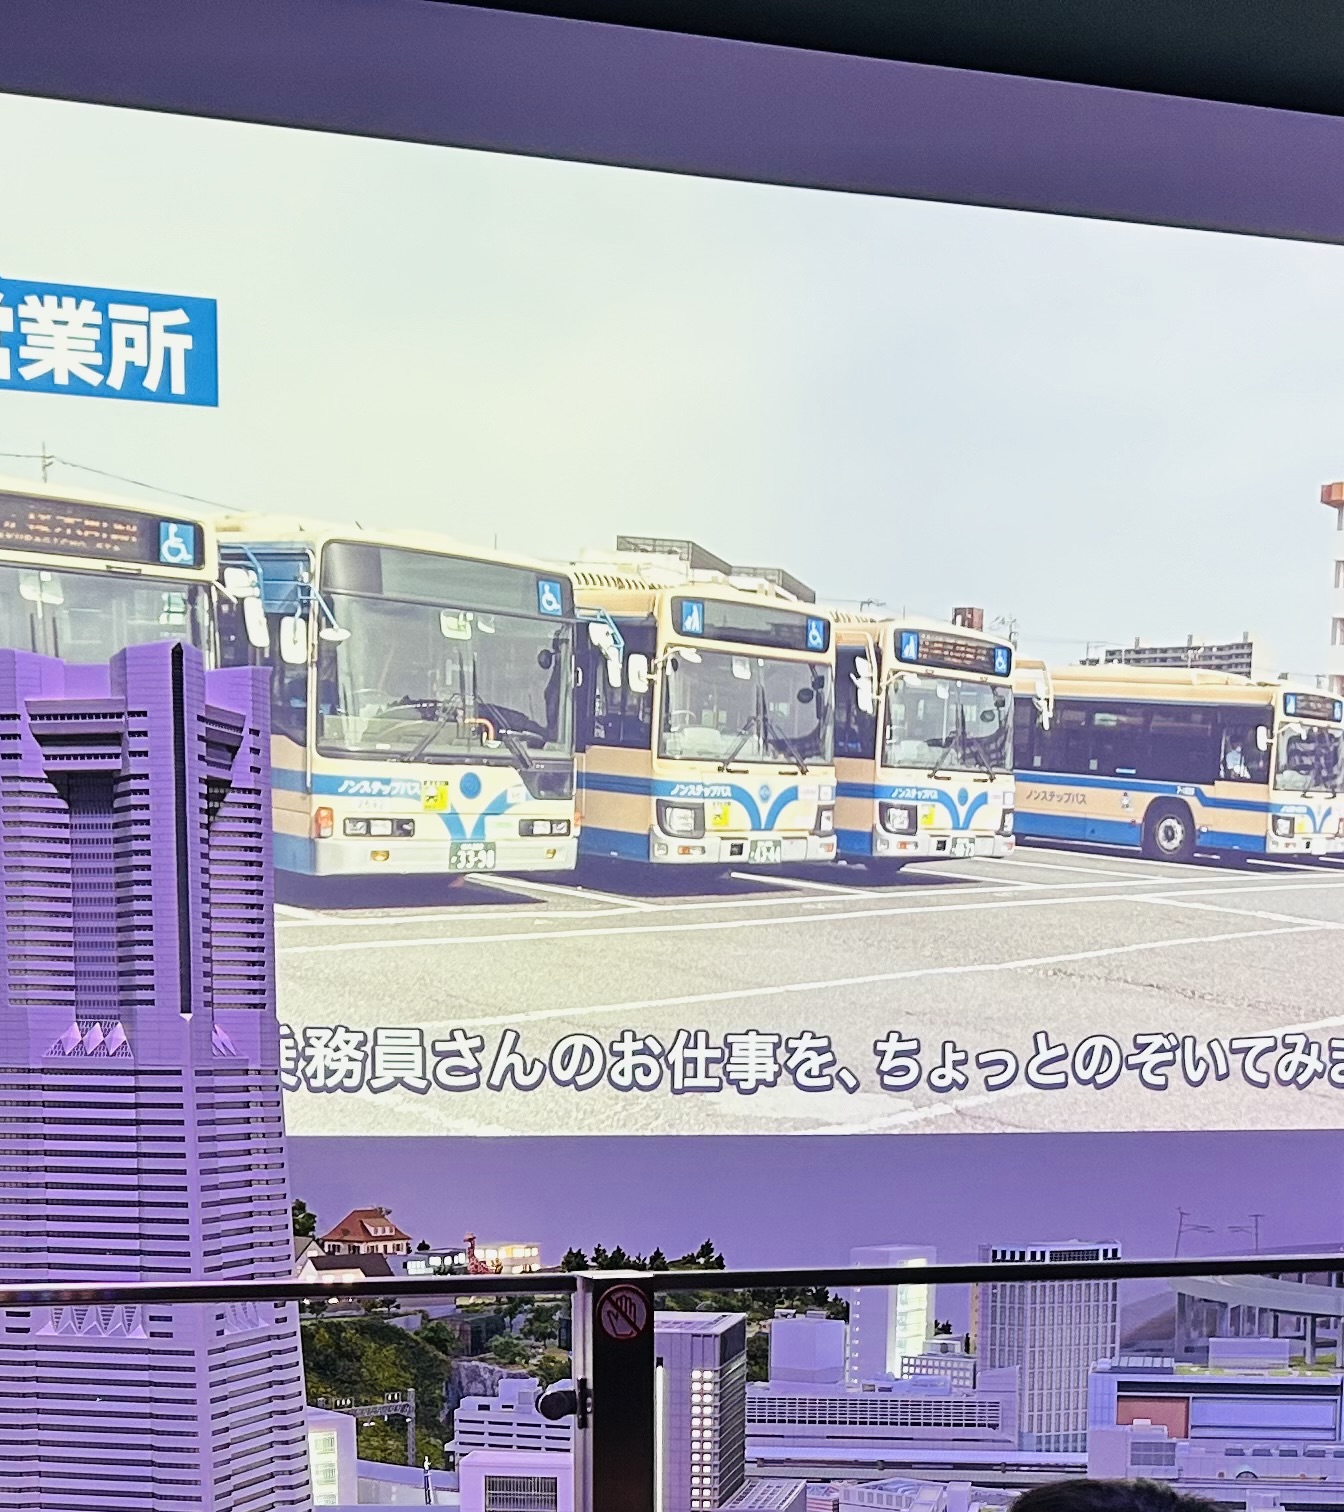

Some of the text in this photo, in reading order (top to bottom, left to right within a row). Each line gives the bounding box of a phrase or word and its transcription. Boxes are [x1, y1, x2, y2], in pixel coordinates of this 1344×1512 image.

[1025, 789, 1087, 805] ノンステップバス
